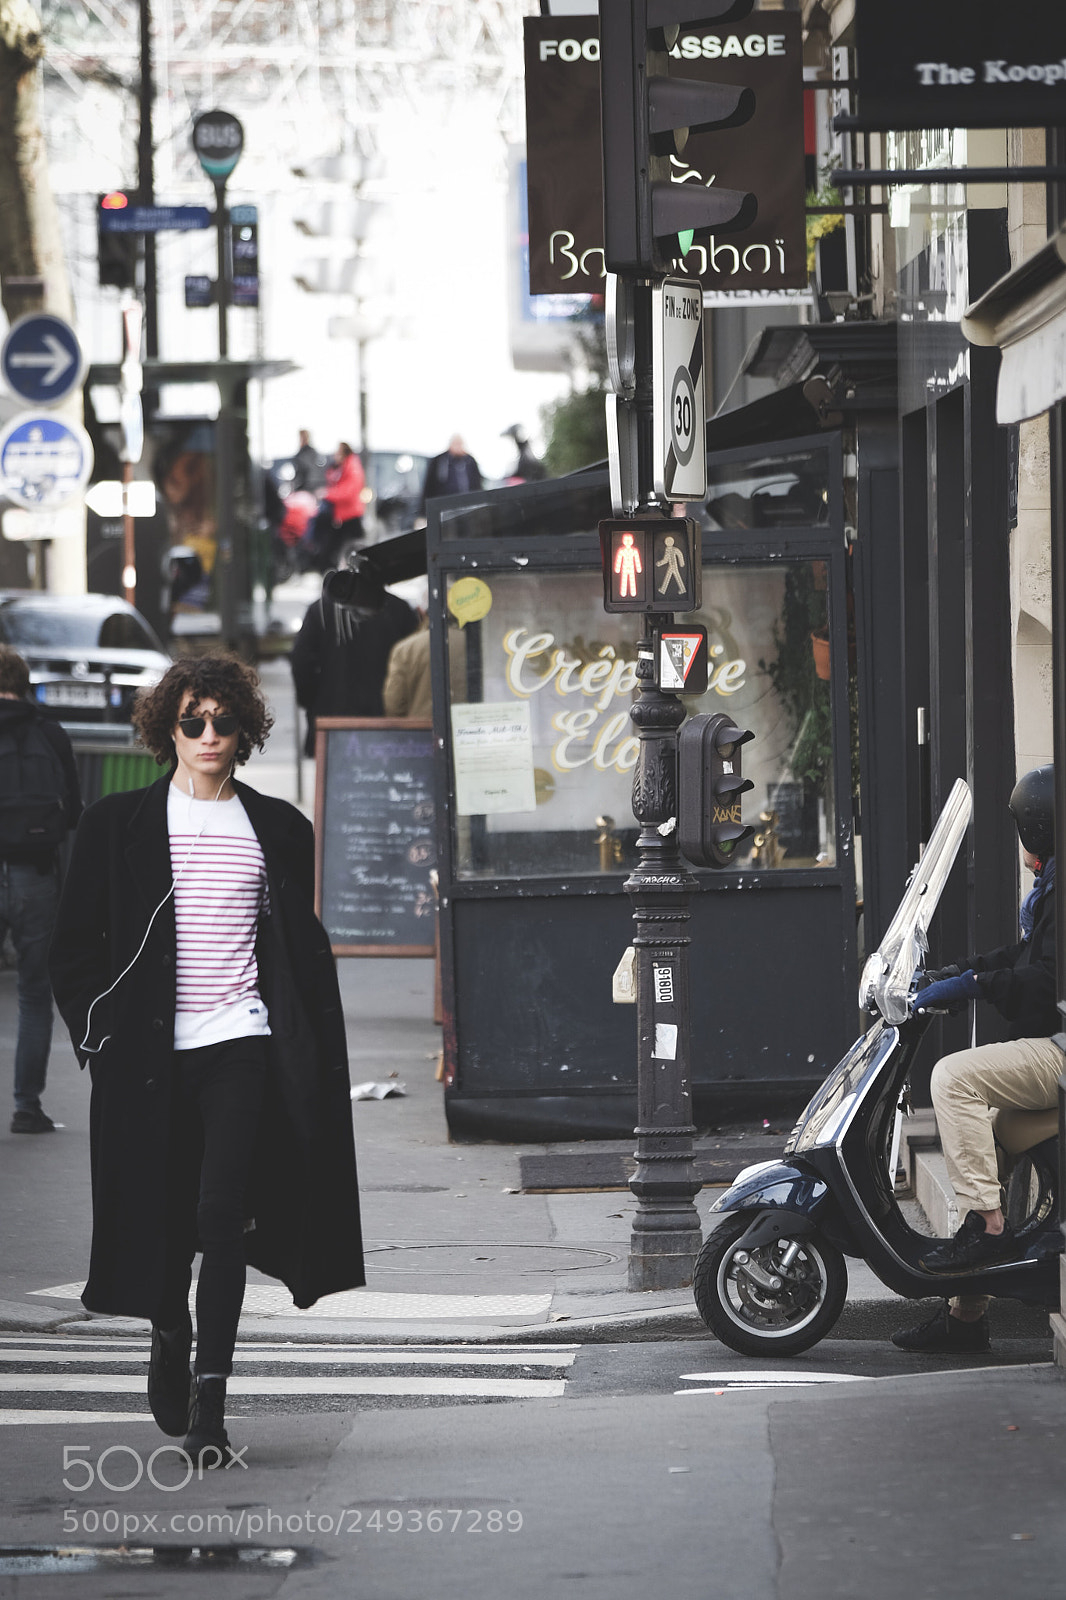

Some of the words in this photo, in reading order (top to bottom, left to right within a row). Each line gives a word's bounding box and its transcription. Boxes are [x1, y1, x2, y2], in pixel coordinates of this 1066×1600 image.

[539, 38, 600, 62] FOO
[669, 34, 786, 60] ASSAGE
[915, 62, 976, 86] The
[665, 295, 676, 318] FIN
[682, 297, 699, 321] ZONE
[675, 395, 691, 437] 30
